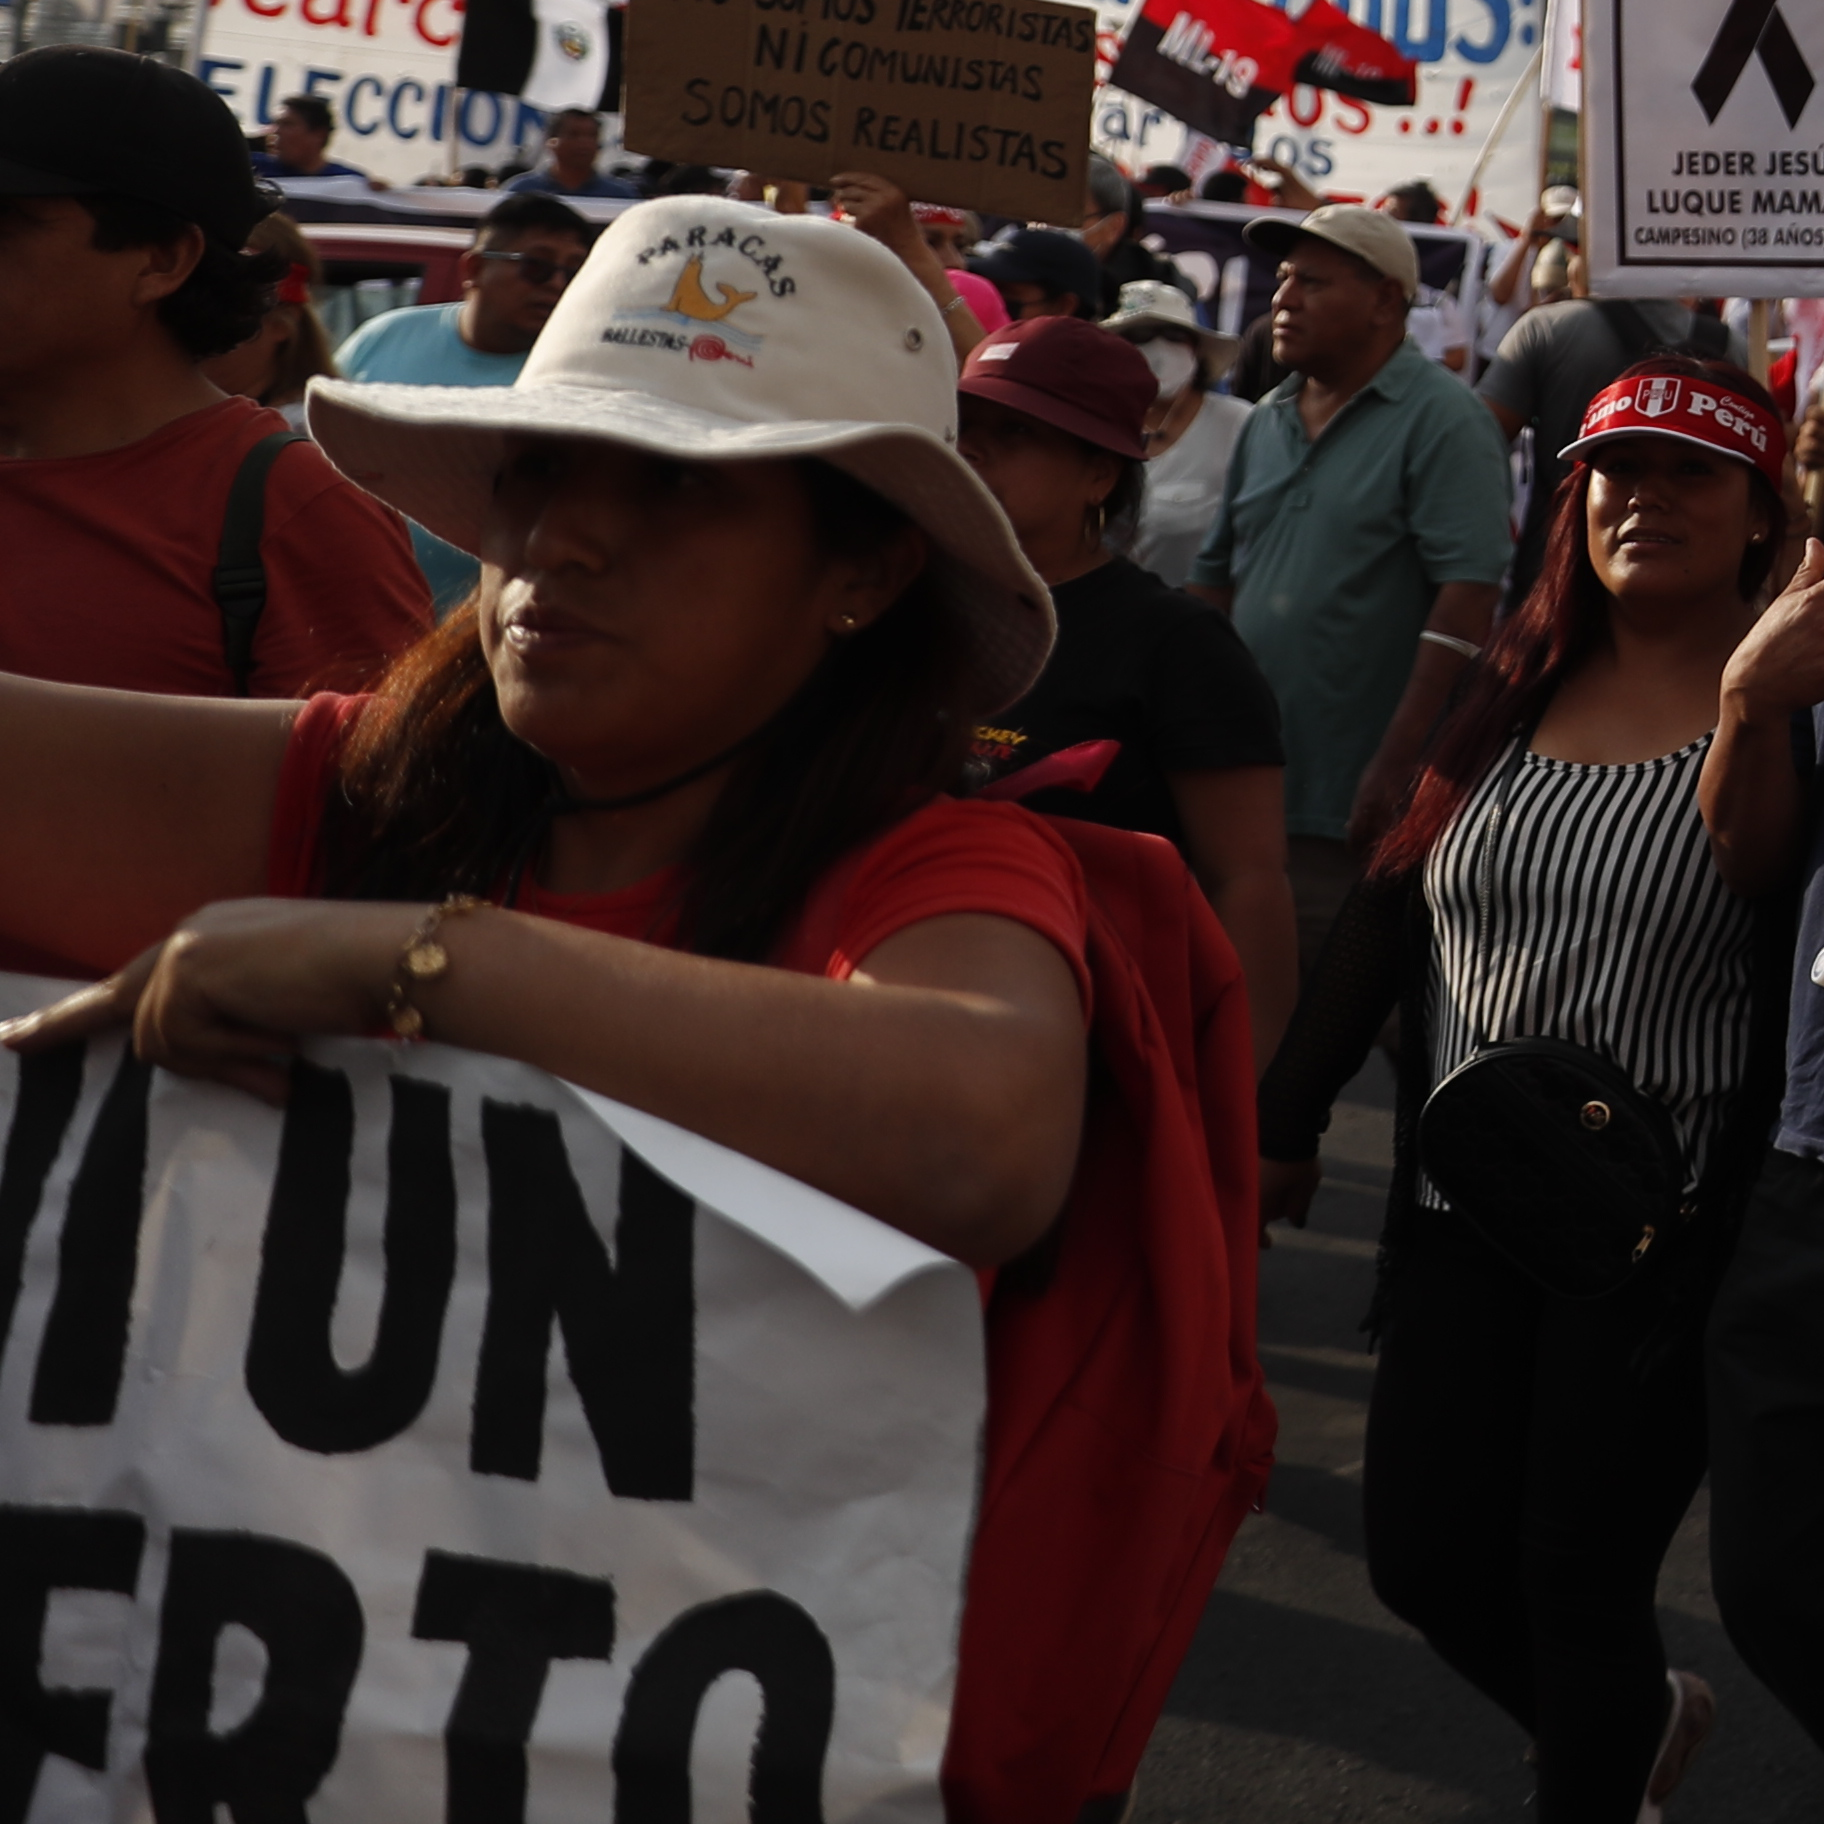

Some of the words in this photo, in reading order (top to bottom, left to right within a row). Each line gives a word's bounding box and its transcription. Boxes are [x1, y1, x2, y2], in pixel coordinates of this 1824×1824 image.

[819, 36, 1043, 101] COMUNISTAS
[682, 79, 832, 144] SOMOS
[853, 107, 1068, 180] REALISTAS
[1672, 151, 1756, 176] JEDER
[1646, 189, 1742, 217] LUQUE
[636, 226, 797, 297] PARACAS
[1634, 226, 1735, 247] CAMPESINO
[1741, 226, 1769, 251] (38
[1687, 391, 1768, 453] Perú
[244, 1052, 697, 1502] UN
